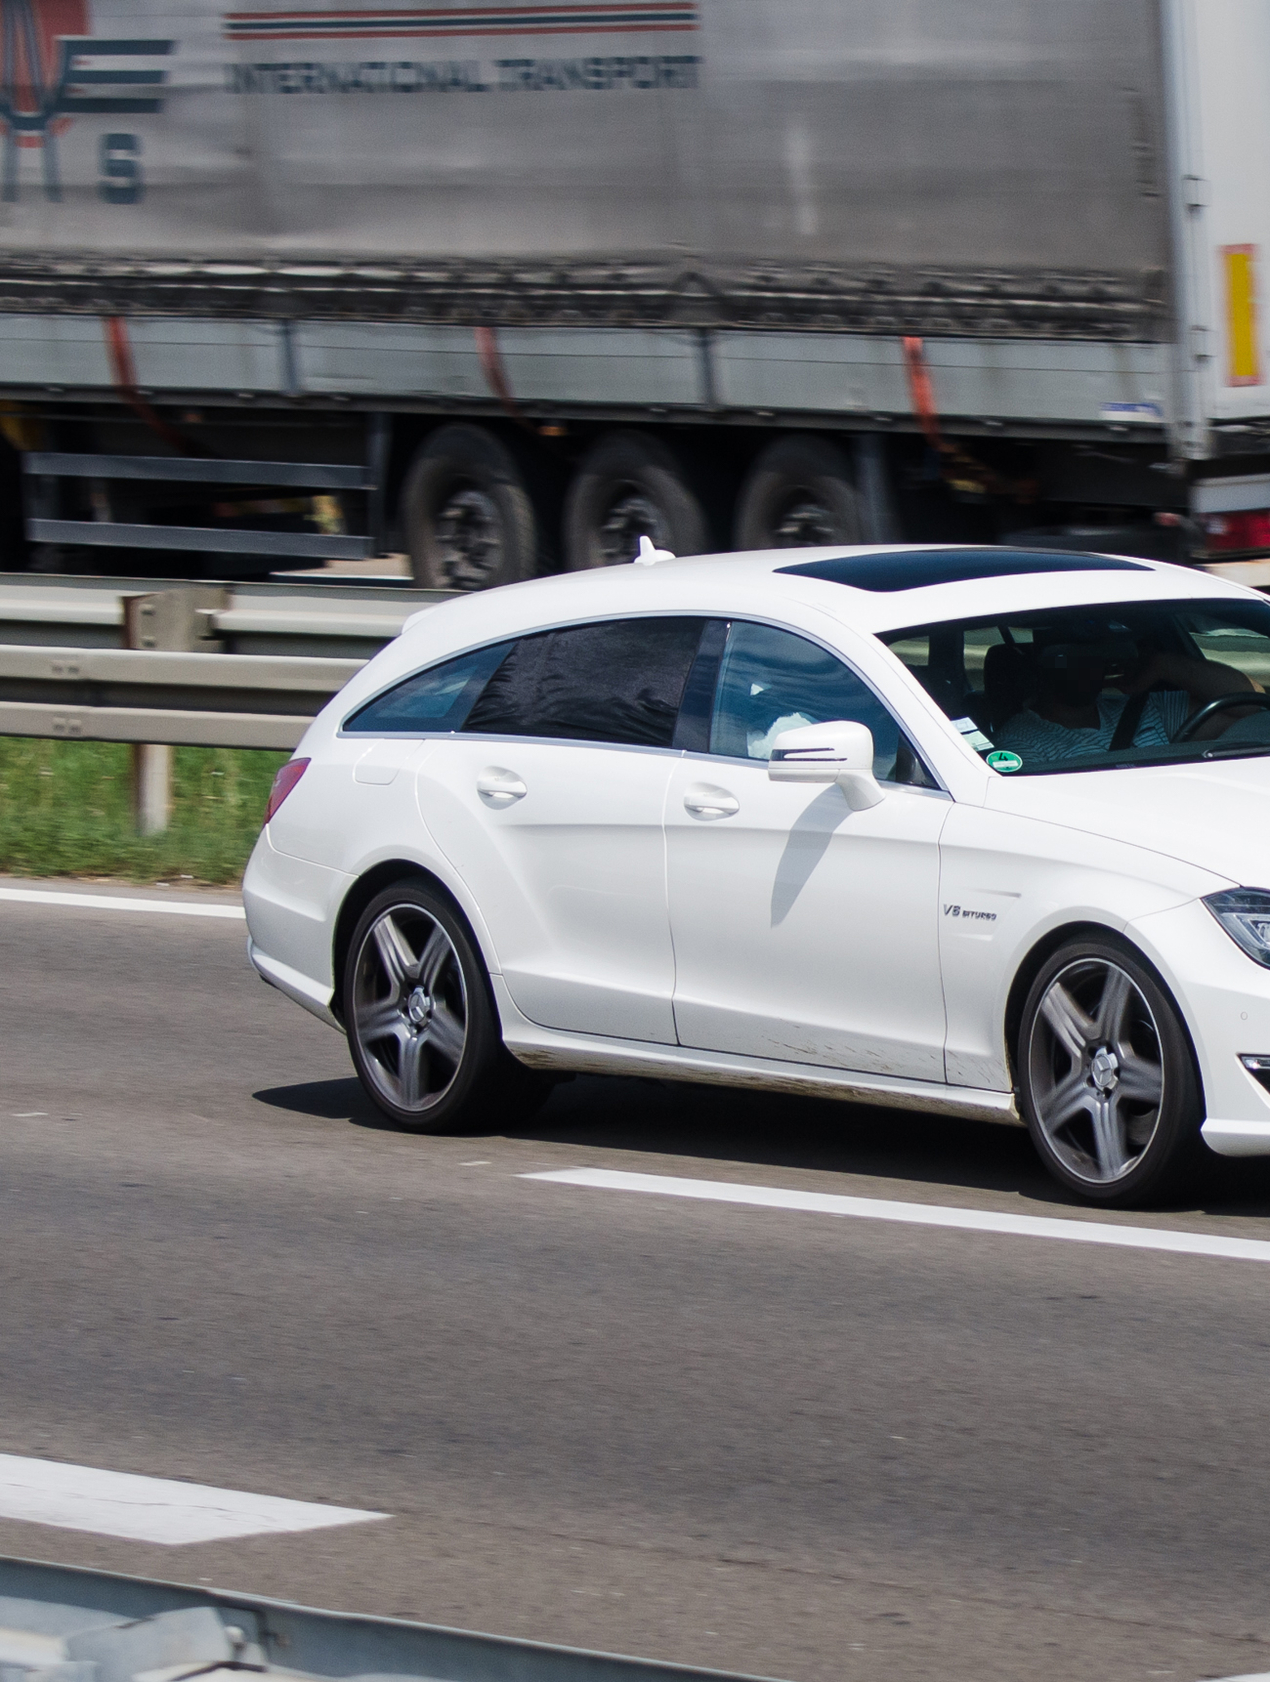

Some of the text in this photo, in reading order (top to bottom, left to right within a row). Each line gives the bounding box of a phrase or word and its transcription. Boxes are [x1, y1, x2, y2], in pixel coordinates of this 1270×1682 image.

[224, 56, 701, 94] INTERNATIONAL TRANSPORT
[943, 904, 961, 917] V8
